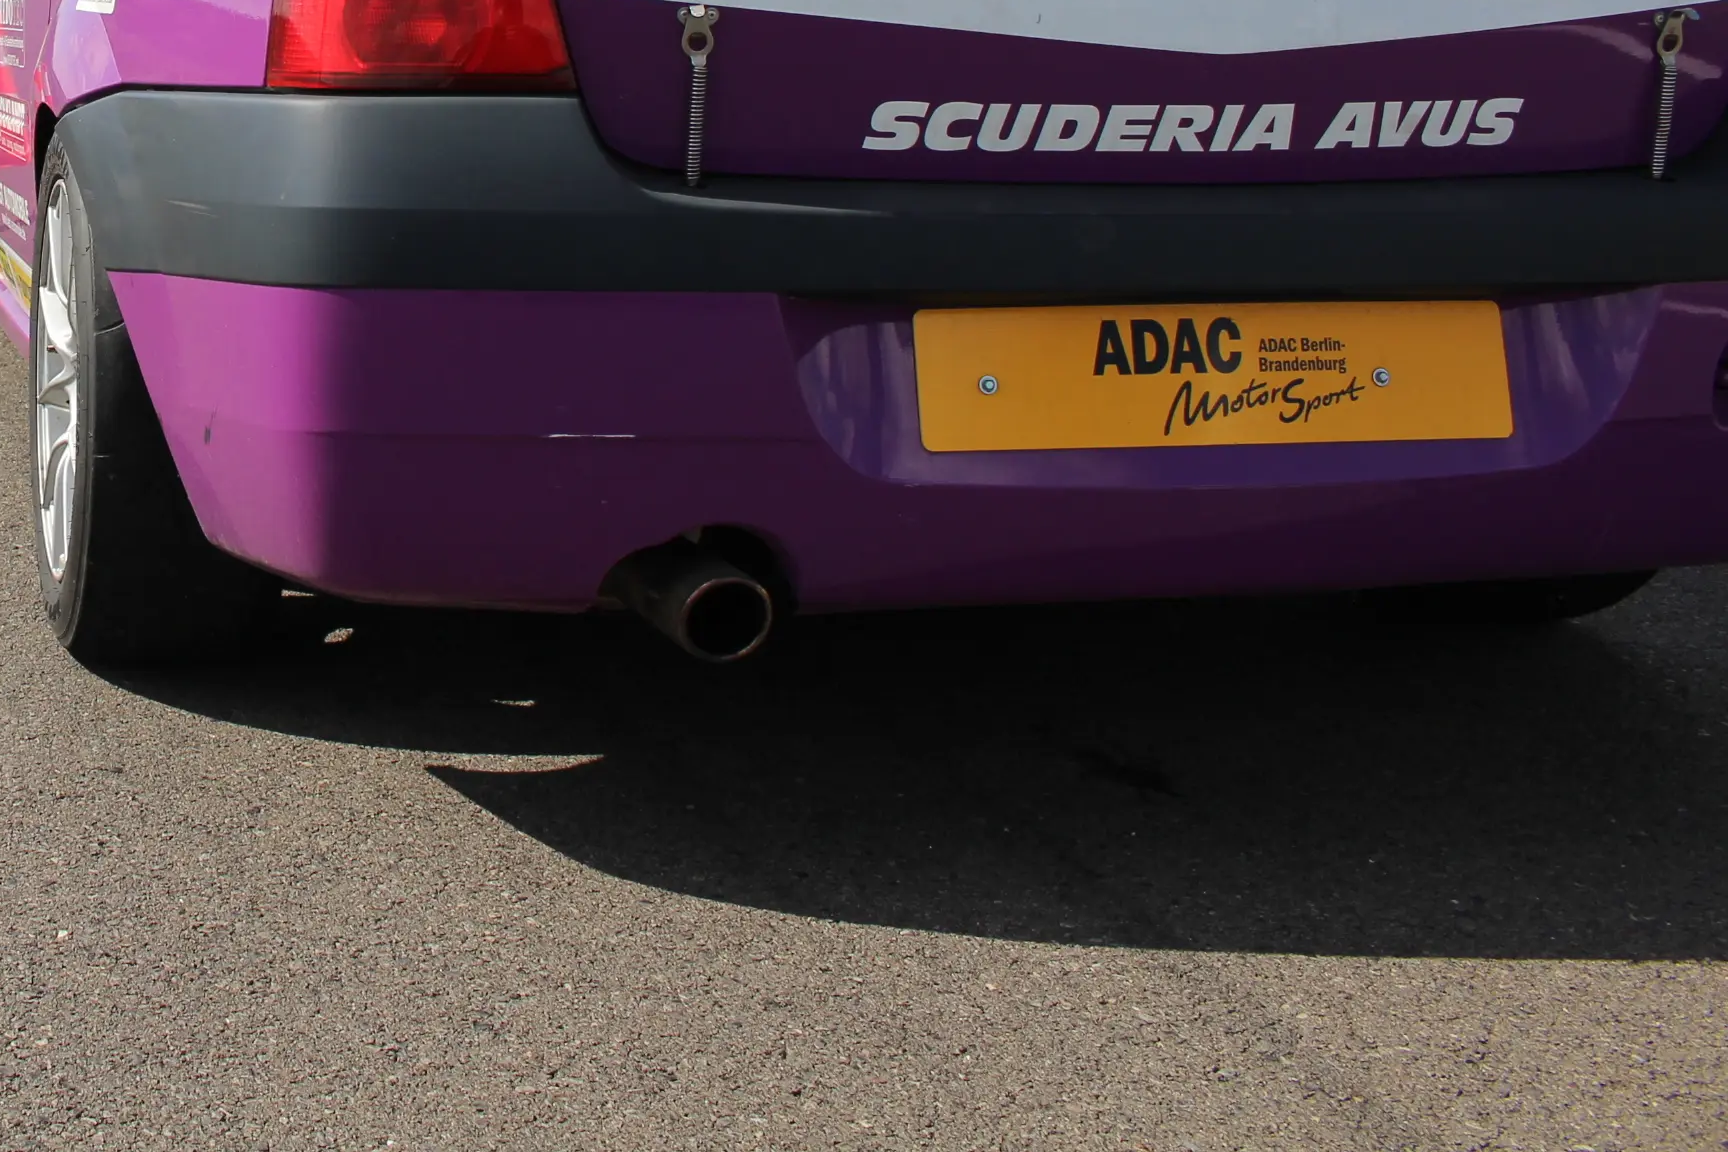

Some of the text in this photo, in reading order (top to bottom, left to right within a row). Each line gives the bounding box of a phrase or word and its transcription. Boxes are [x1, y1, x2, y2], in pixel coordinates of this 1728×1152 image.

[862, 97, 1525, 153] SCUDERIA AVUS
[1093, 316, 1243, 376] ADAC
[1258, 337, 1346, 353] ADAC Berlin-
[1258, 356, 1347, 374] Brandenburg
